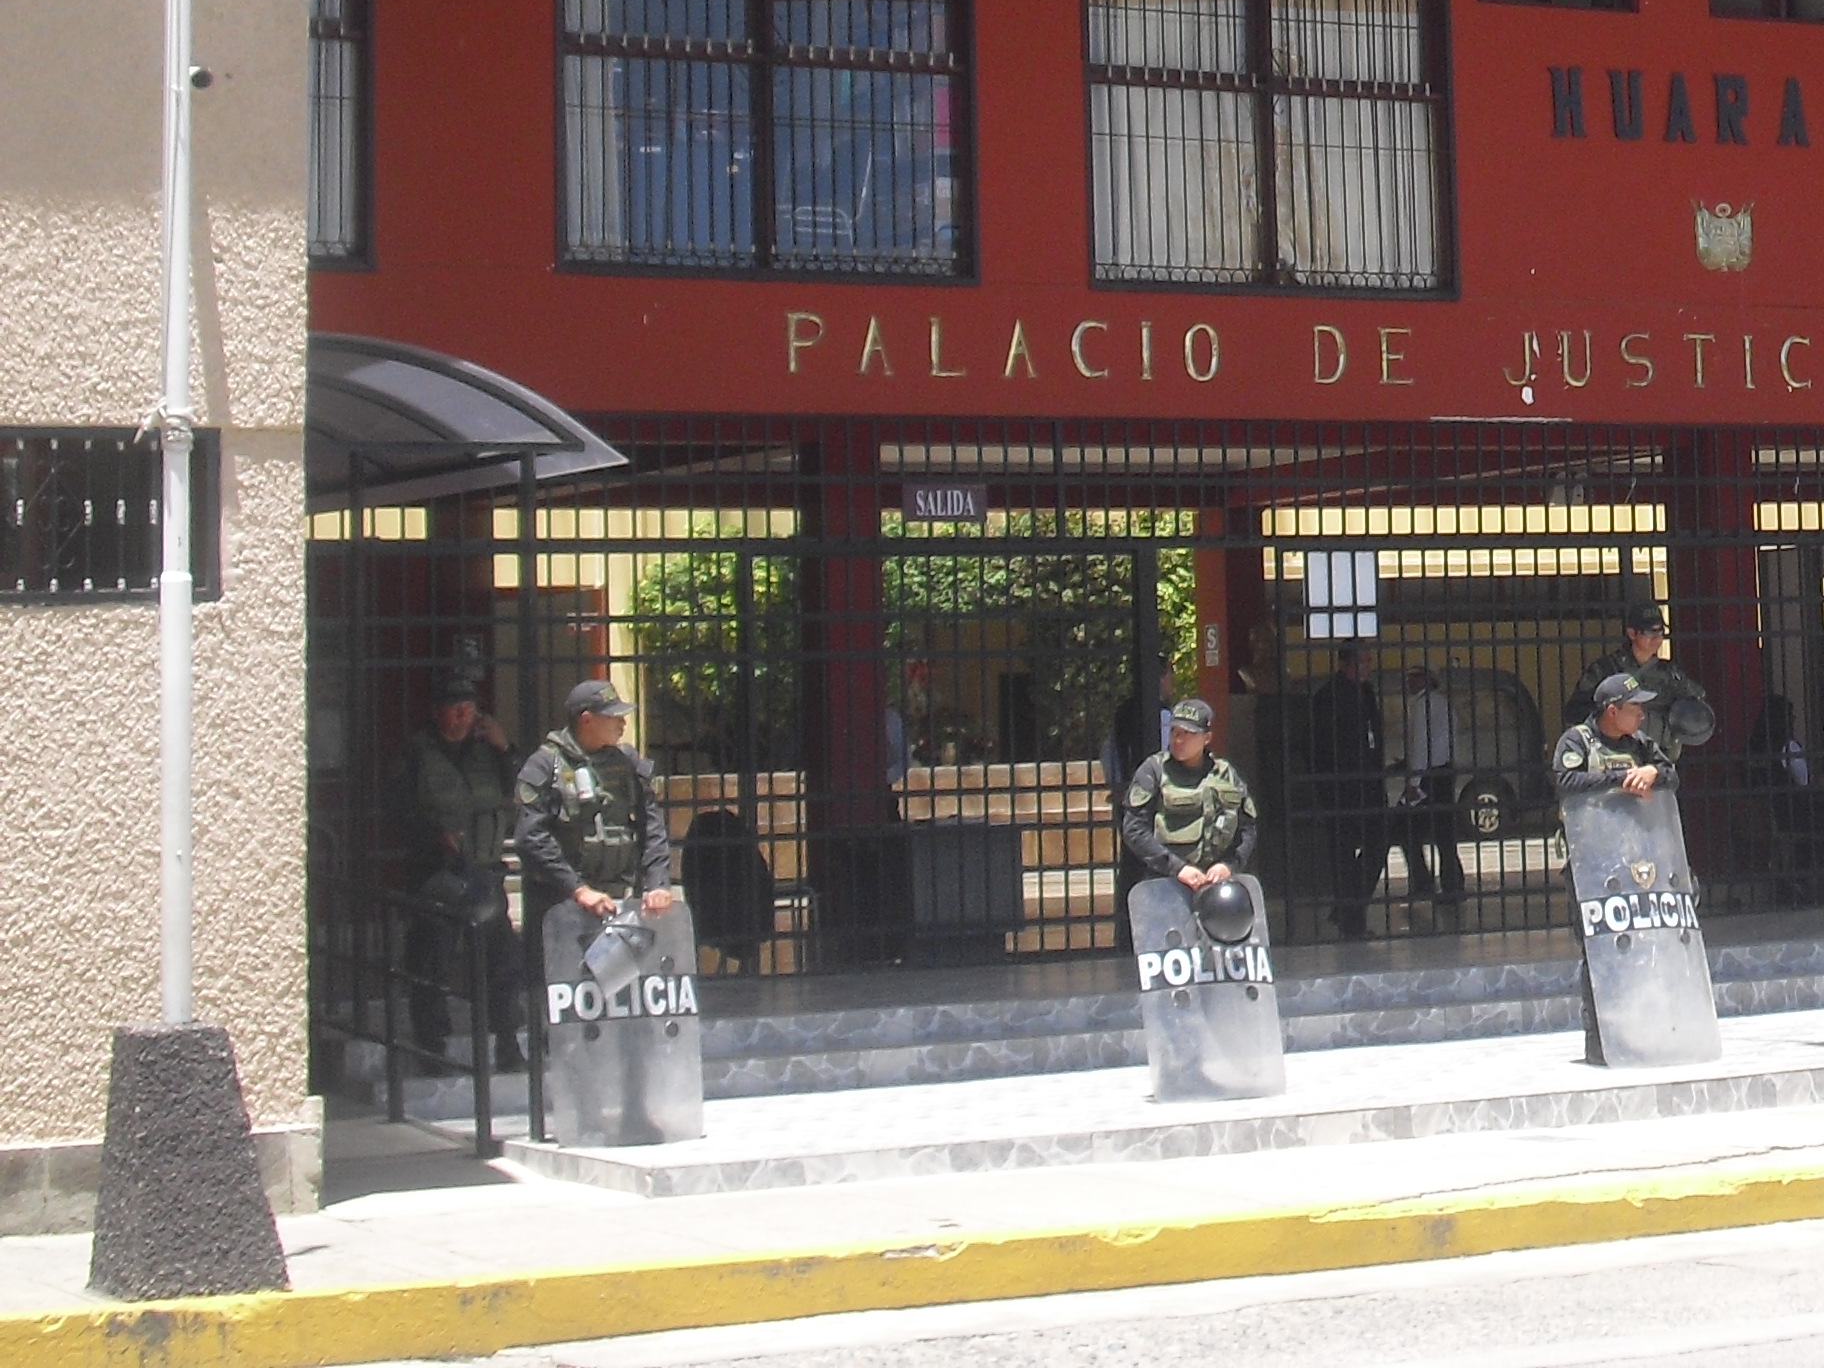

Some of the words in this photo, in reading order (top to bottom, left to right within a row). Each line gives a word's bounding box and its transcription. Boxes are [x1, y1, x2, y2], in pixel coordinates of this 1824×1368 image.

[786, 311, 1222, 383] PALACIO
[1311, 323, 1415, 386] DE
[915, 490, 976, 517] SALIDA
[1207, 629, 1216, 649] S
[1581, 891, 1700, 937] POLICIA
[1138, 946, 1274, 991] POLICIA
[547, 975, 699, 1025] POLICIA
